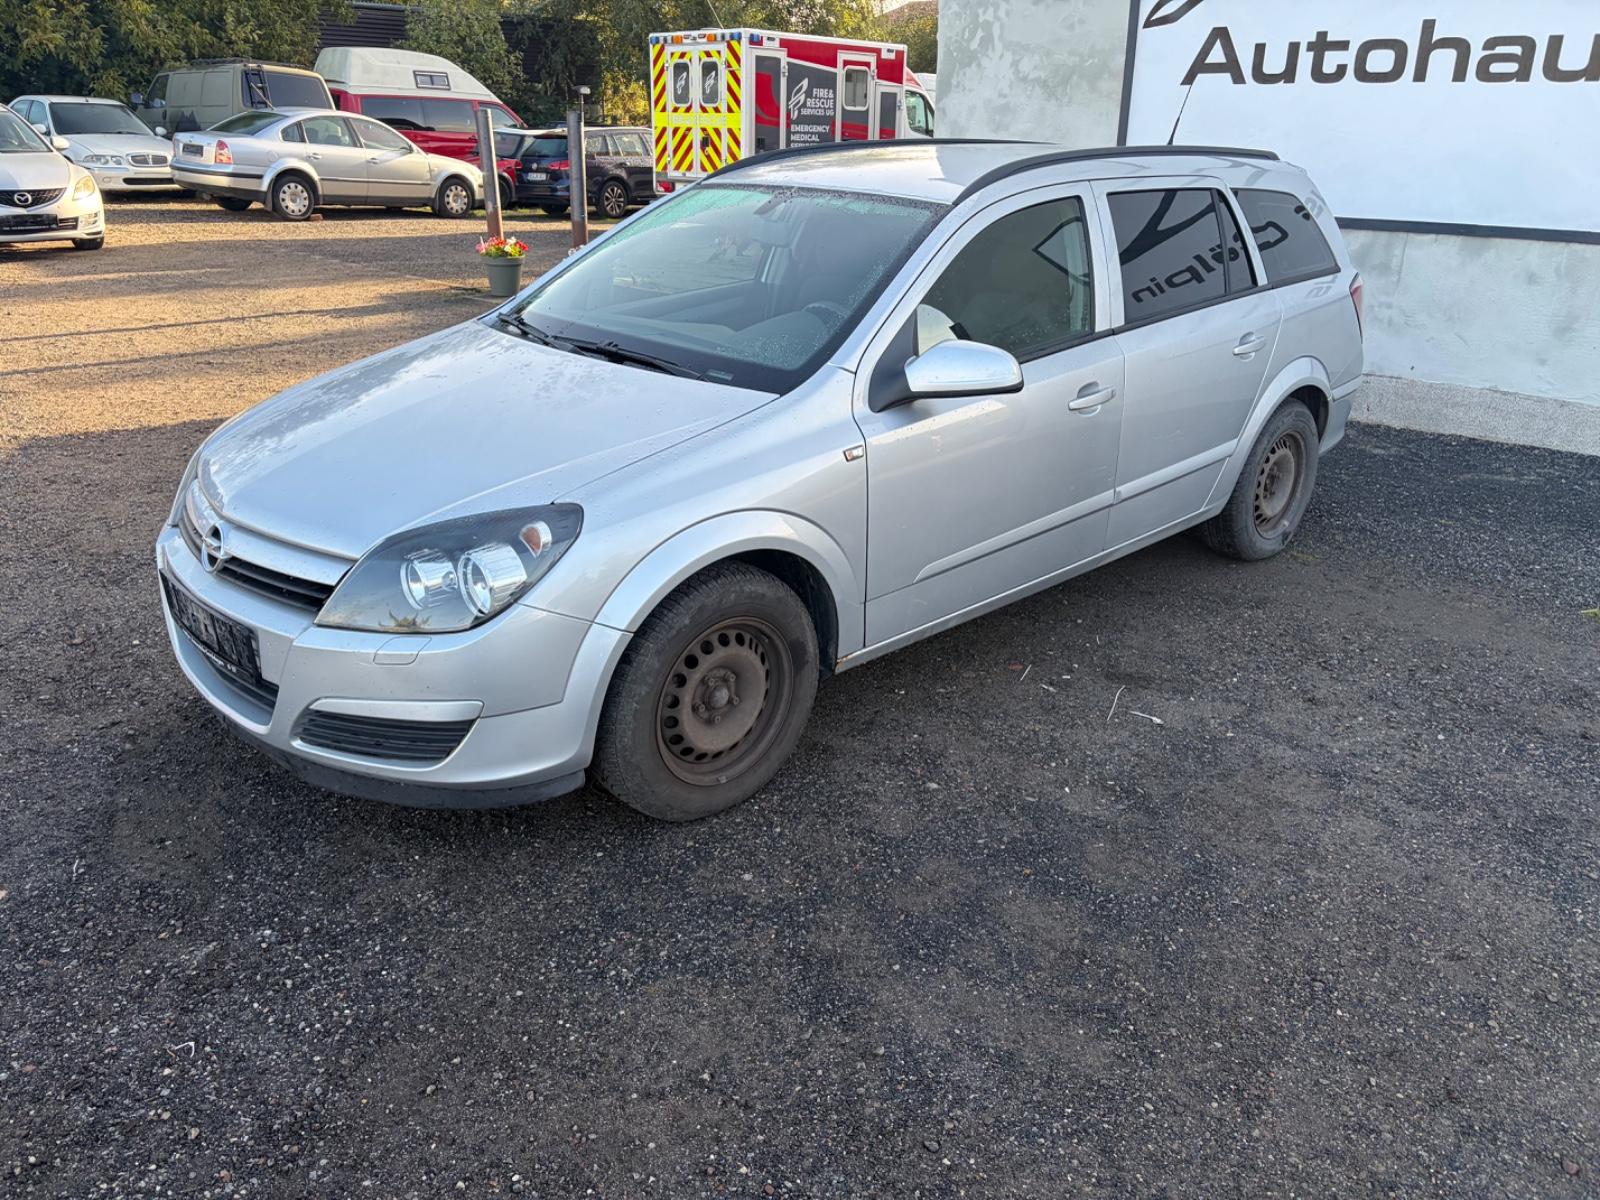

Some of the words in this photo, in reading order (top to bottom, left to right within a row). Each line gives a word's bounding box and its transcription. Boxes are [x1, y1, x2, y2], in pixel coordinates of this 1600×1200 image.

[1180, 18, 1600, 86] Autohau
[806, 98, 834, 108] RESCUE
[790, 124, 830, 133] EMERGENCY
[790, 133, 820, 141] MEDICAL
